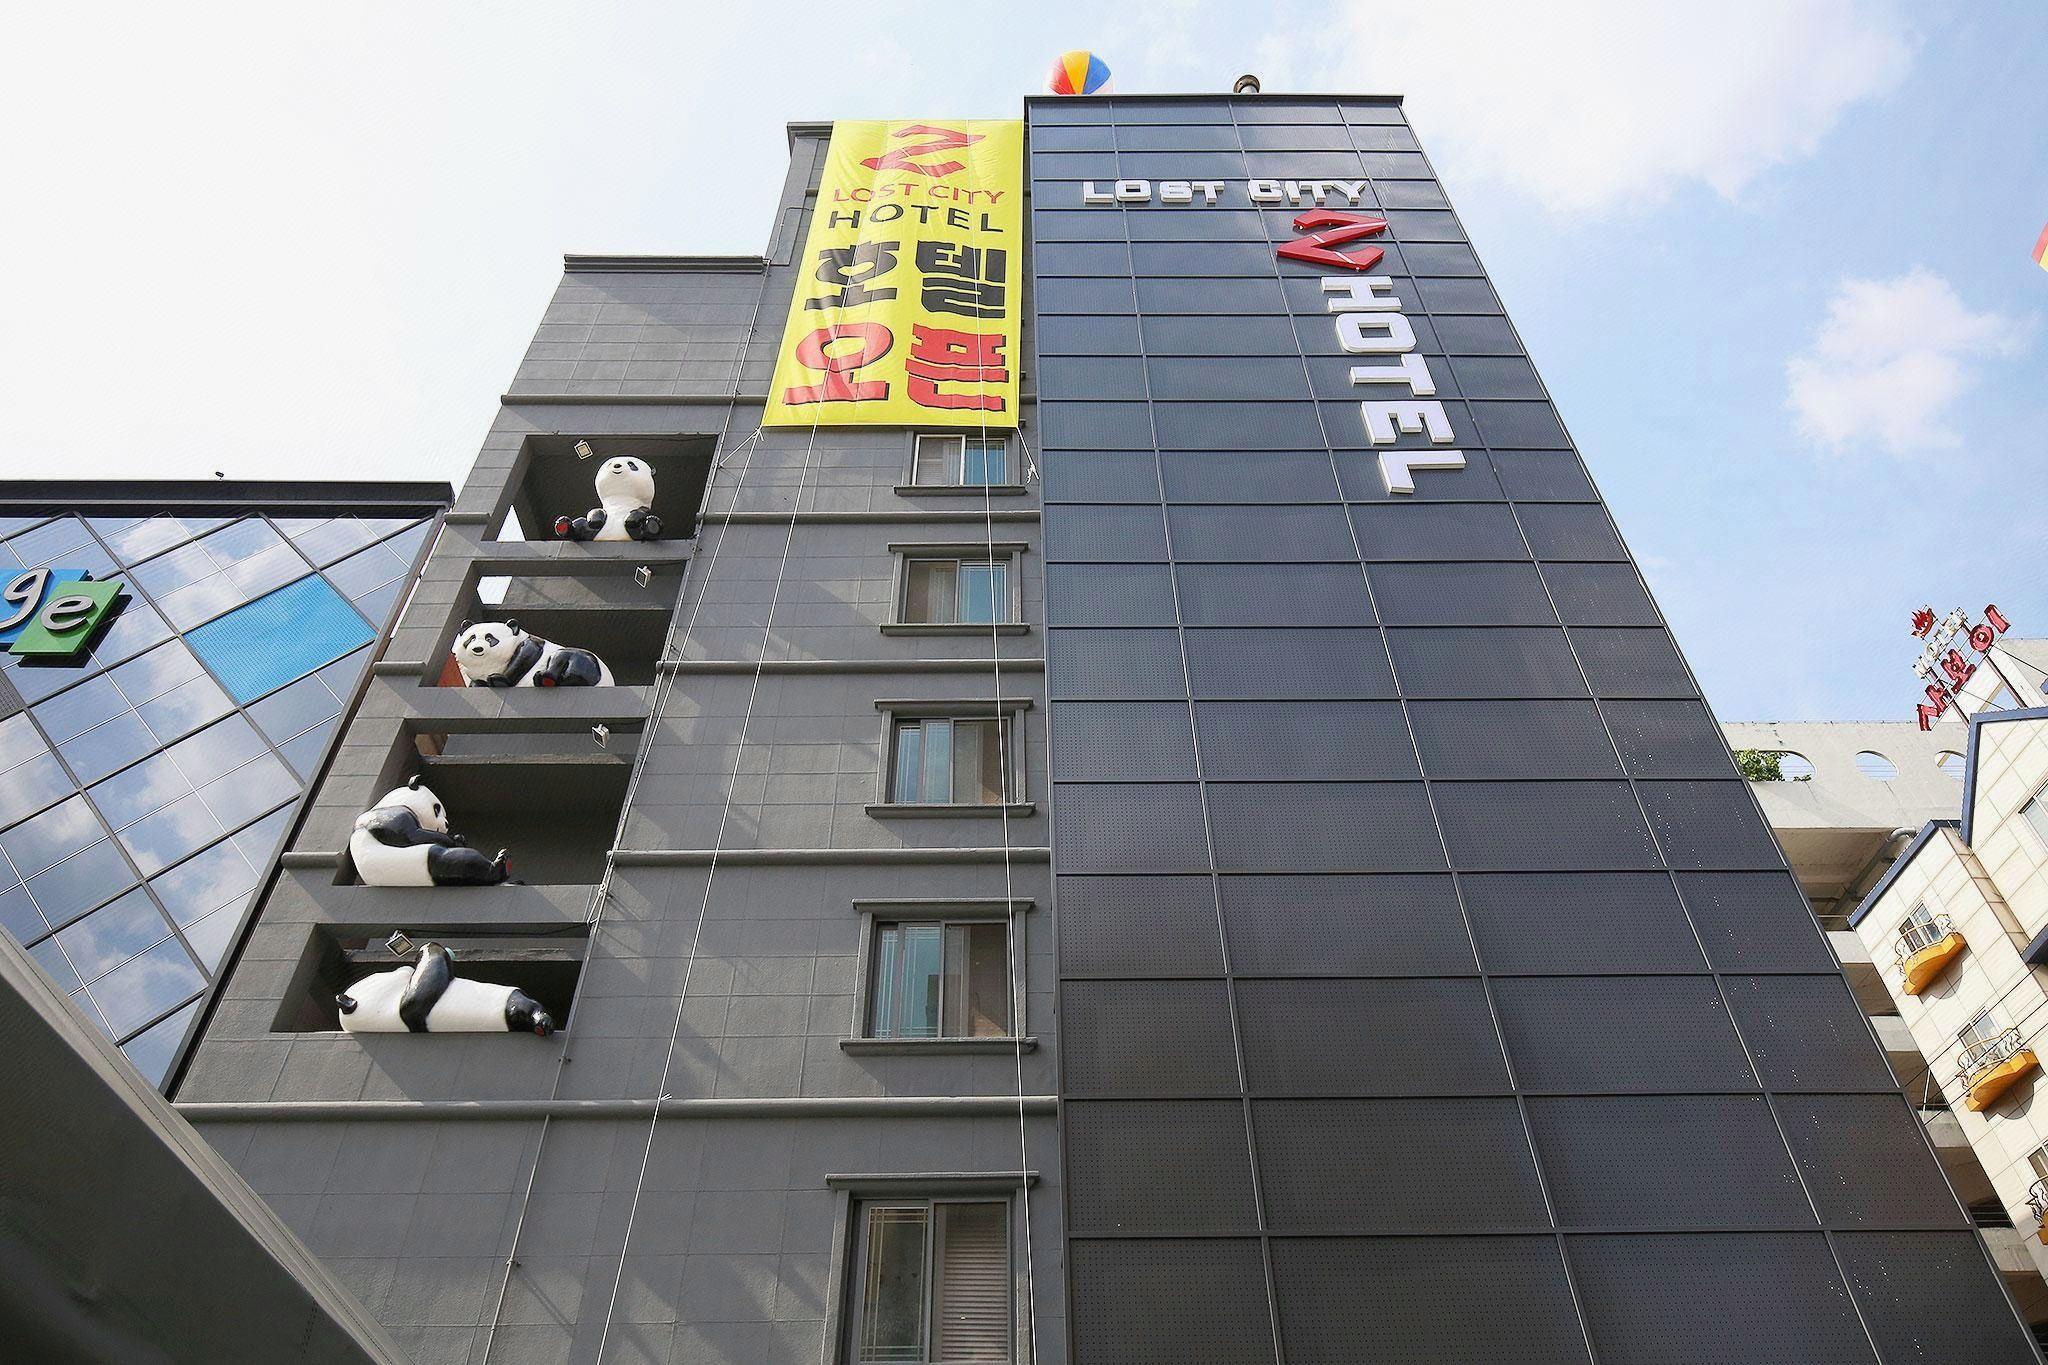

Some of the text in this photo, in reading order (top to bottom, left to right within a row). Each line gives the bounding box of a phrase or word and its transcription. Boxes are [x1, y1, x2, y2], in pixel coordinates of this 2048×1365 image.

[828, 204, 1004, 232] HOTEL
[833, 183, 1006, 205] LOST CITY
[1082, 178, 1367, 205] LOST CITY
[803, 239, 1008, 319] 호텔
[782, 322, 1010, 412] 오픈
[1320, 275, 1467, 494] HOTEL
[1916, 604, 2012, 731] 사보이
